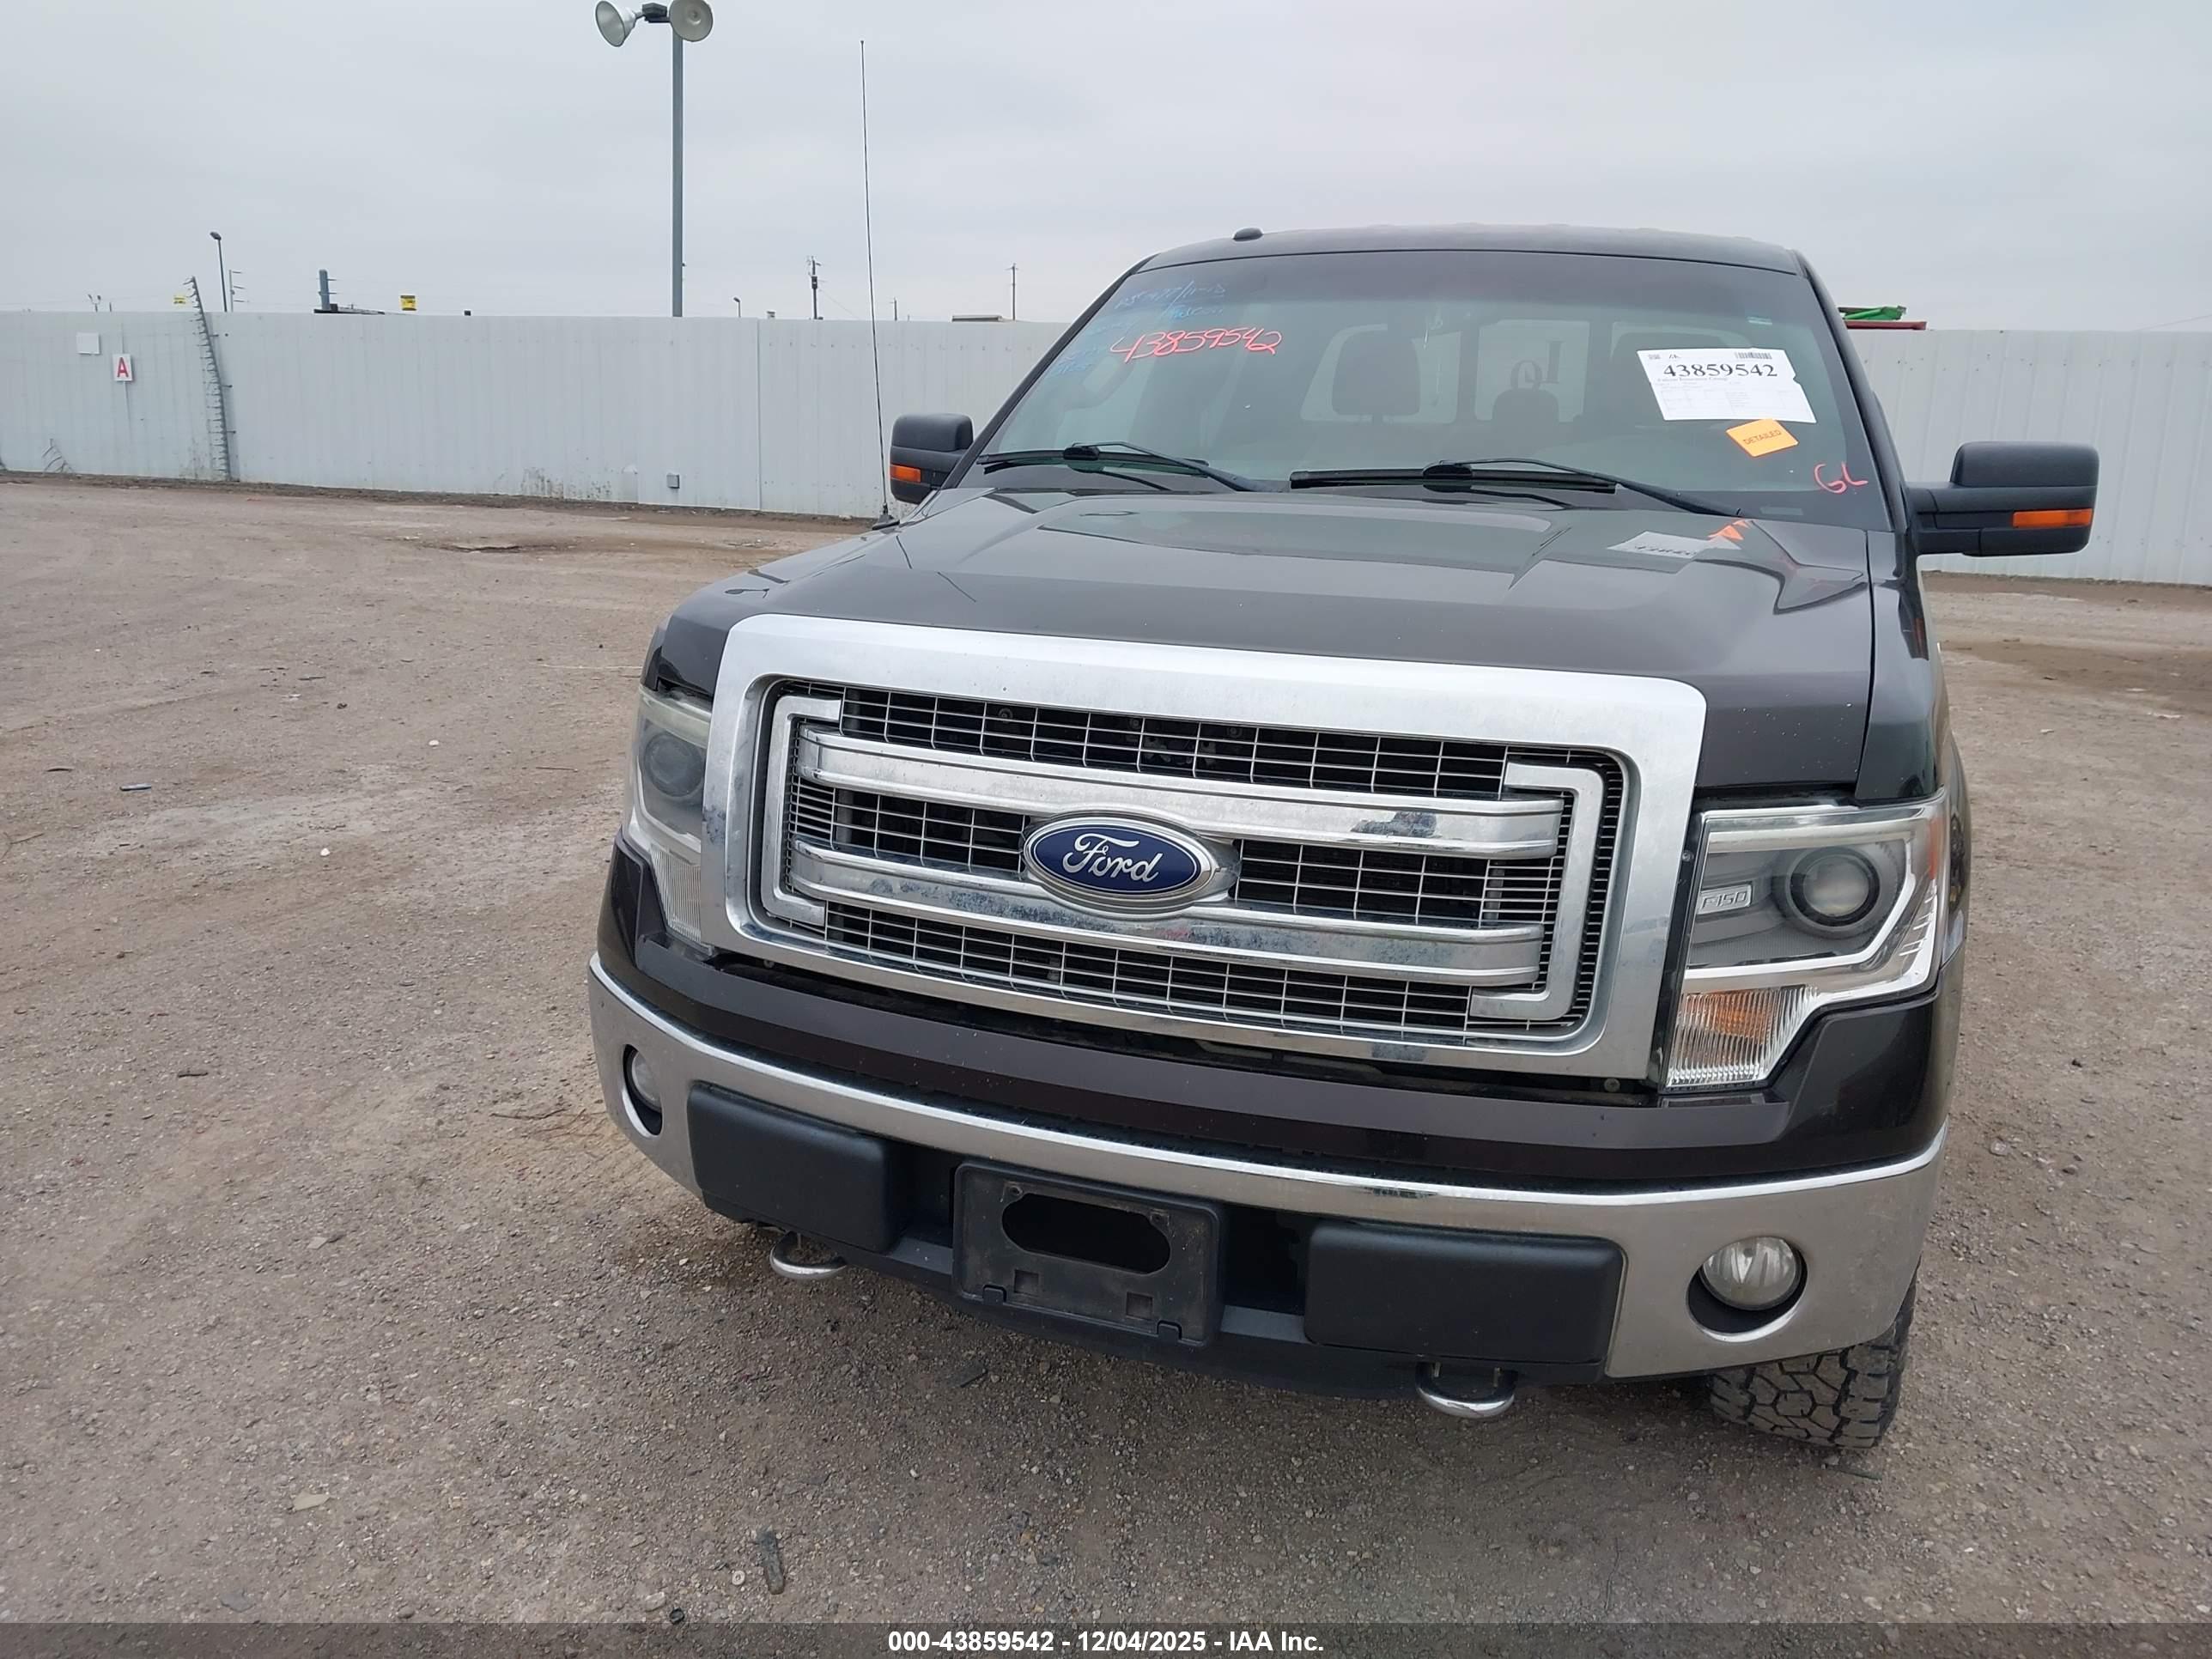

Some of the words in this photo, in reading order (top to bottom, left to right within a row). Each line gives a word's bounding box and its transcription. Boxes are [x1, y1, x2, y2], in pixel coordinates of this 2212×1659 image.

[1110, 326, 1283, 364] 43859542
[117, 356, 129, 378] A
[1663, 363, 1778, 377] 43859542
[1742, 429, 1783, 446] DETAILED
[1062, 833, 1164, 883] Ford
